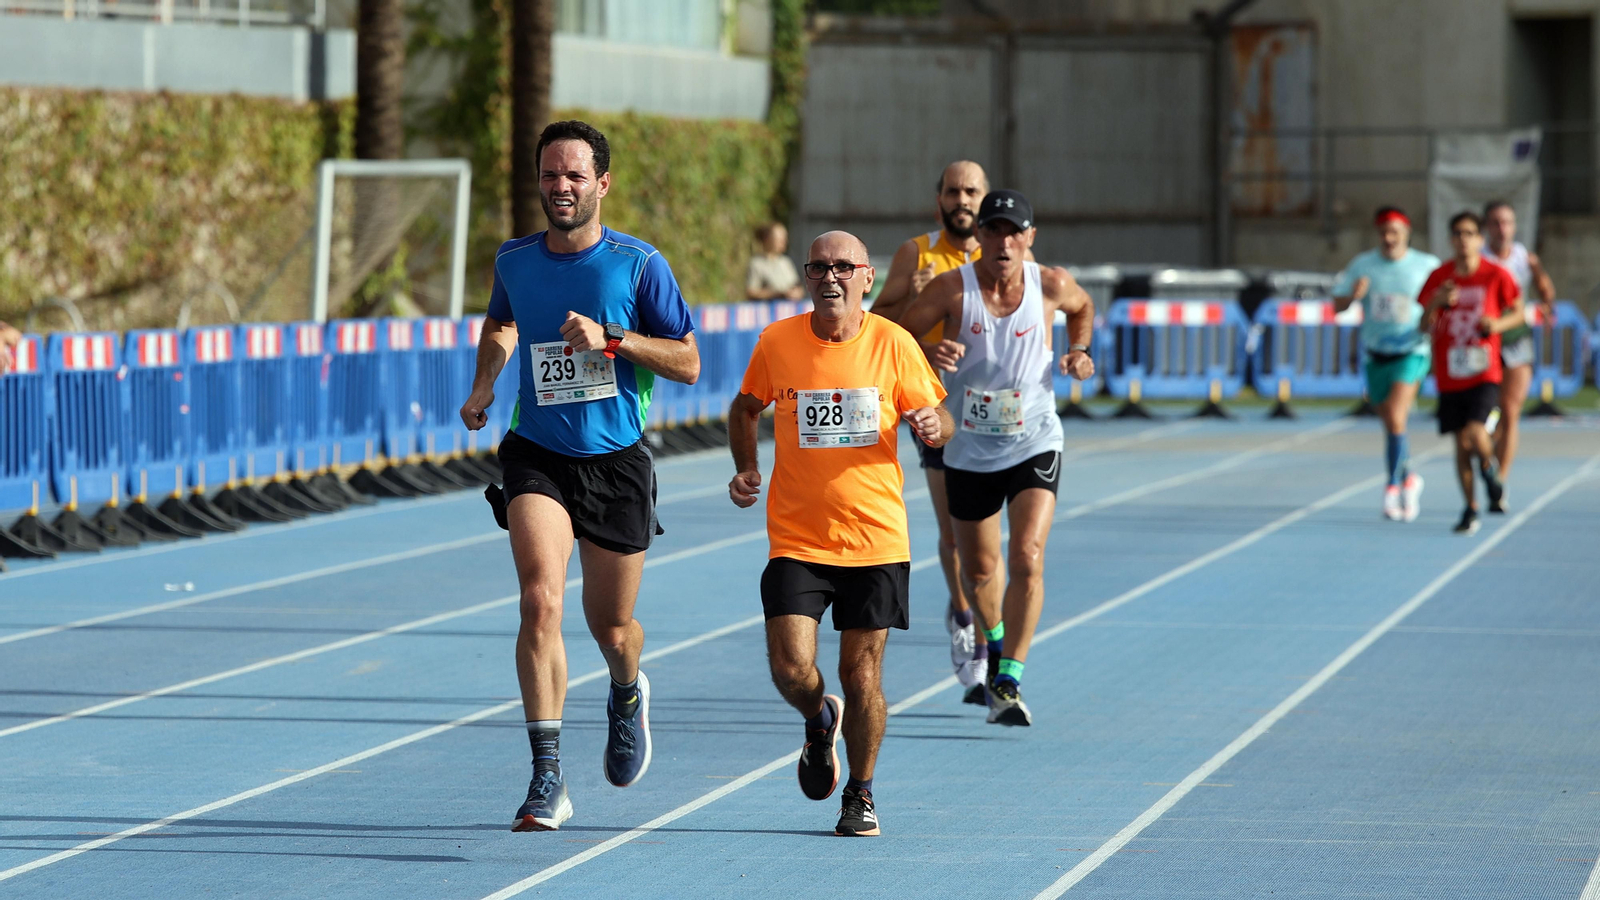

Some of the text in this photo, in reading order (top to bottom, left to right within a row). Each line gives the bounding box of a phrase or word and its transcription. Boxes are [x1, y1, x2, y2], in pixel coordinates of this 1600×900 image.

[540, 358, 575, 382] 239
[806, 405, 843, 427] 928
[970, 403, 988, 419] 45
